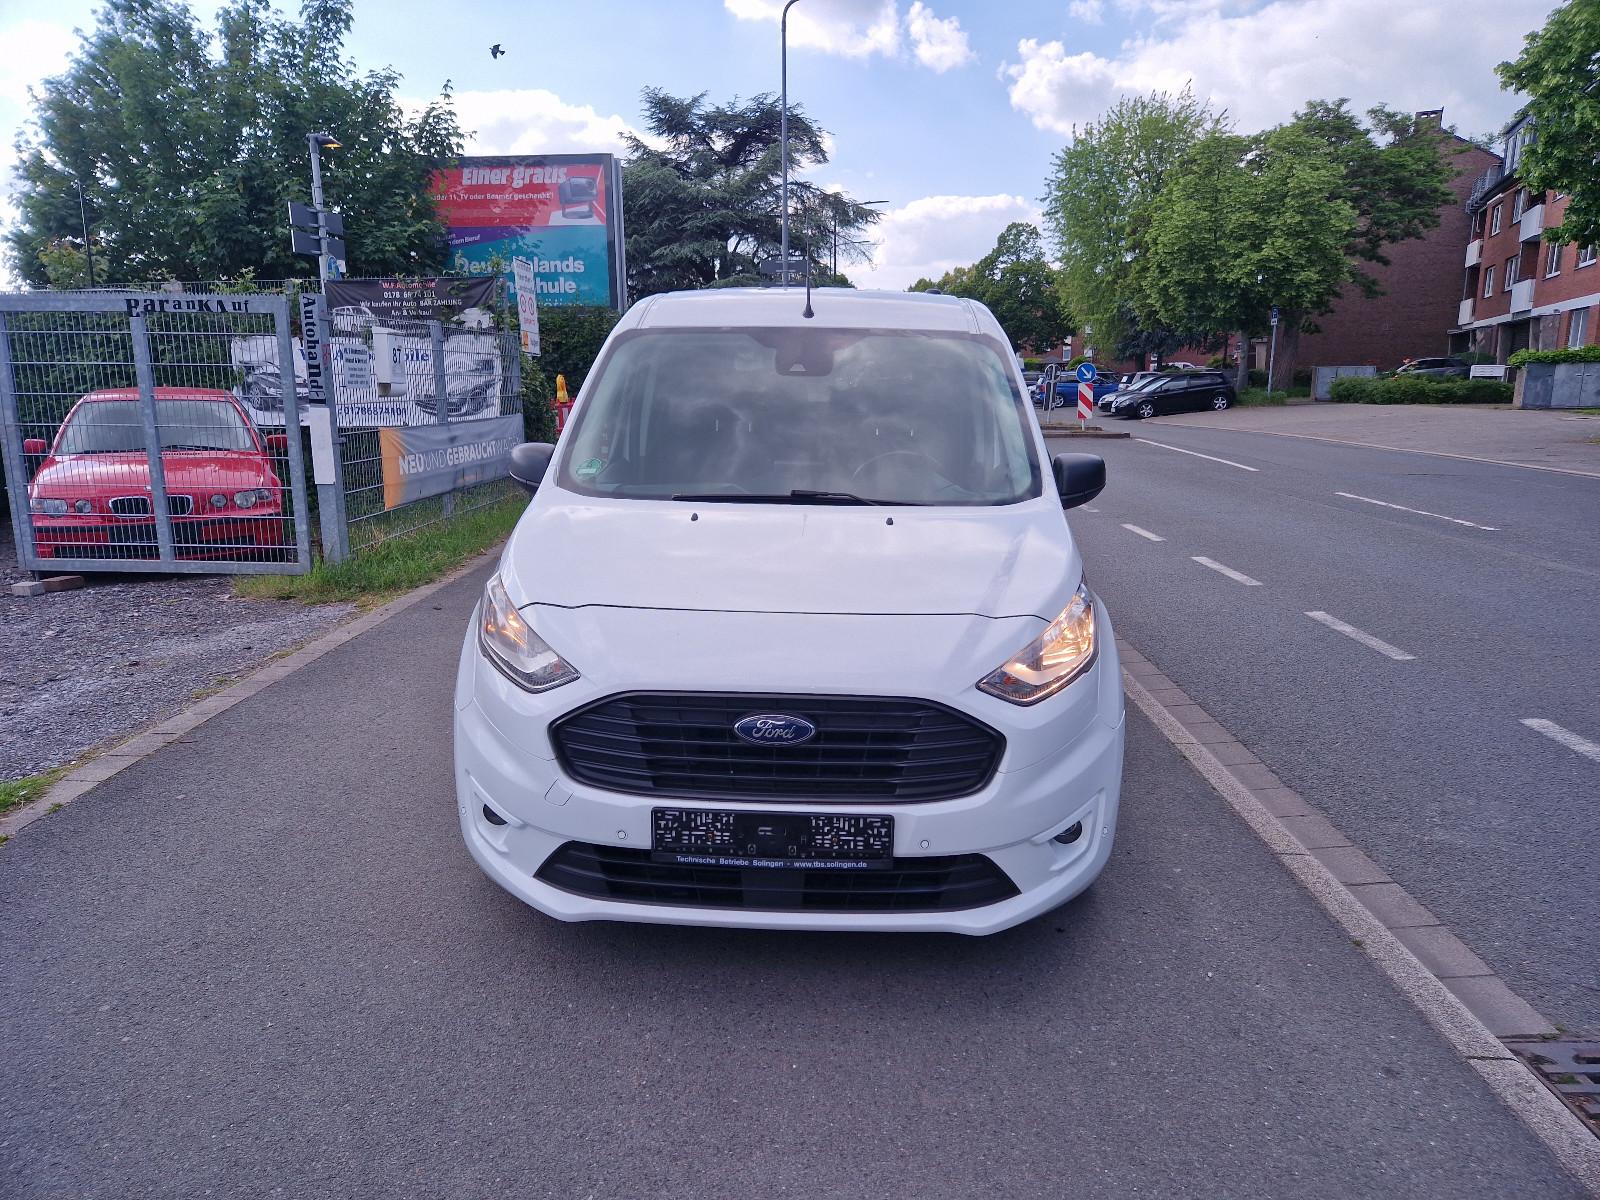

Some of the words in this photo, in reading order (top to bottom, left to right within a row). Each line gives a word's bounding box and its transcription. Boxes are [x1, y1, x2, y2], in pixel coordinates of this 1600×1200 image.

[462, 167, 510, 185] Einer
[383, 291, 400, 299] 0178
[752, 719, 796, 738] Ford
[676, 855, 716, 864] Technische
[719, 857, 749, 866] Betriebe
[752, 859, 784, 868] Solingen
[793, 860, 867, 869] www.tbs.solingen.de
